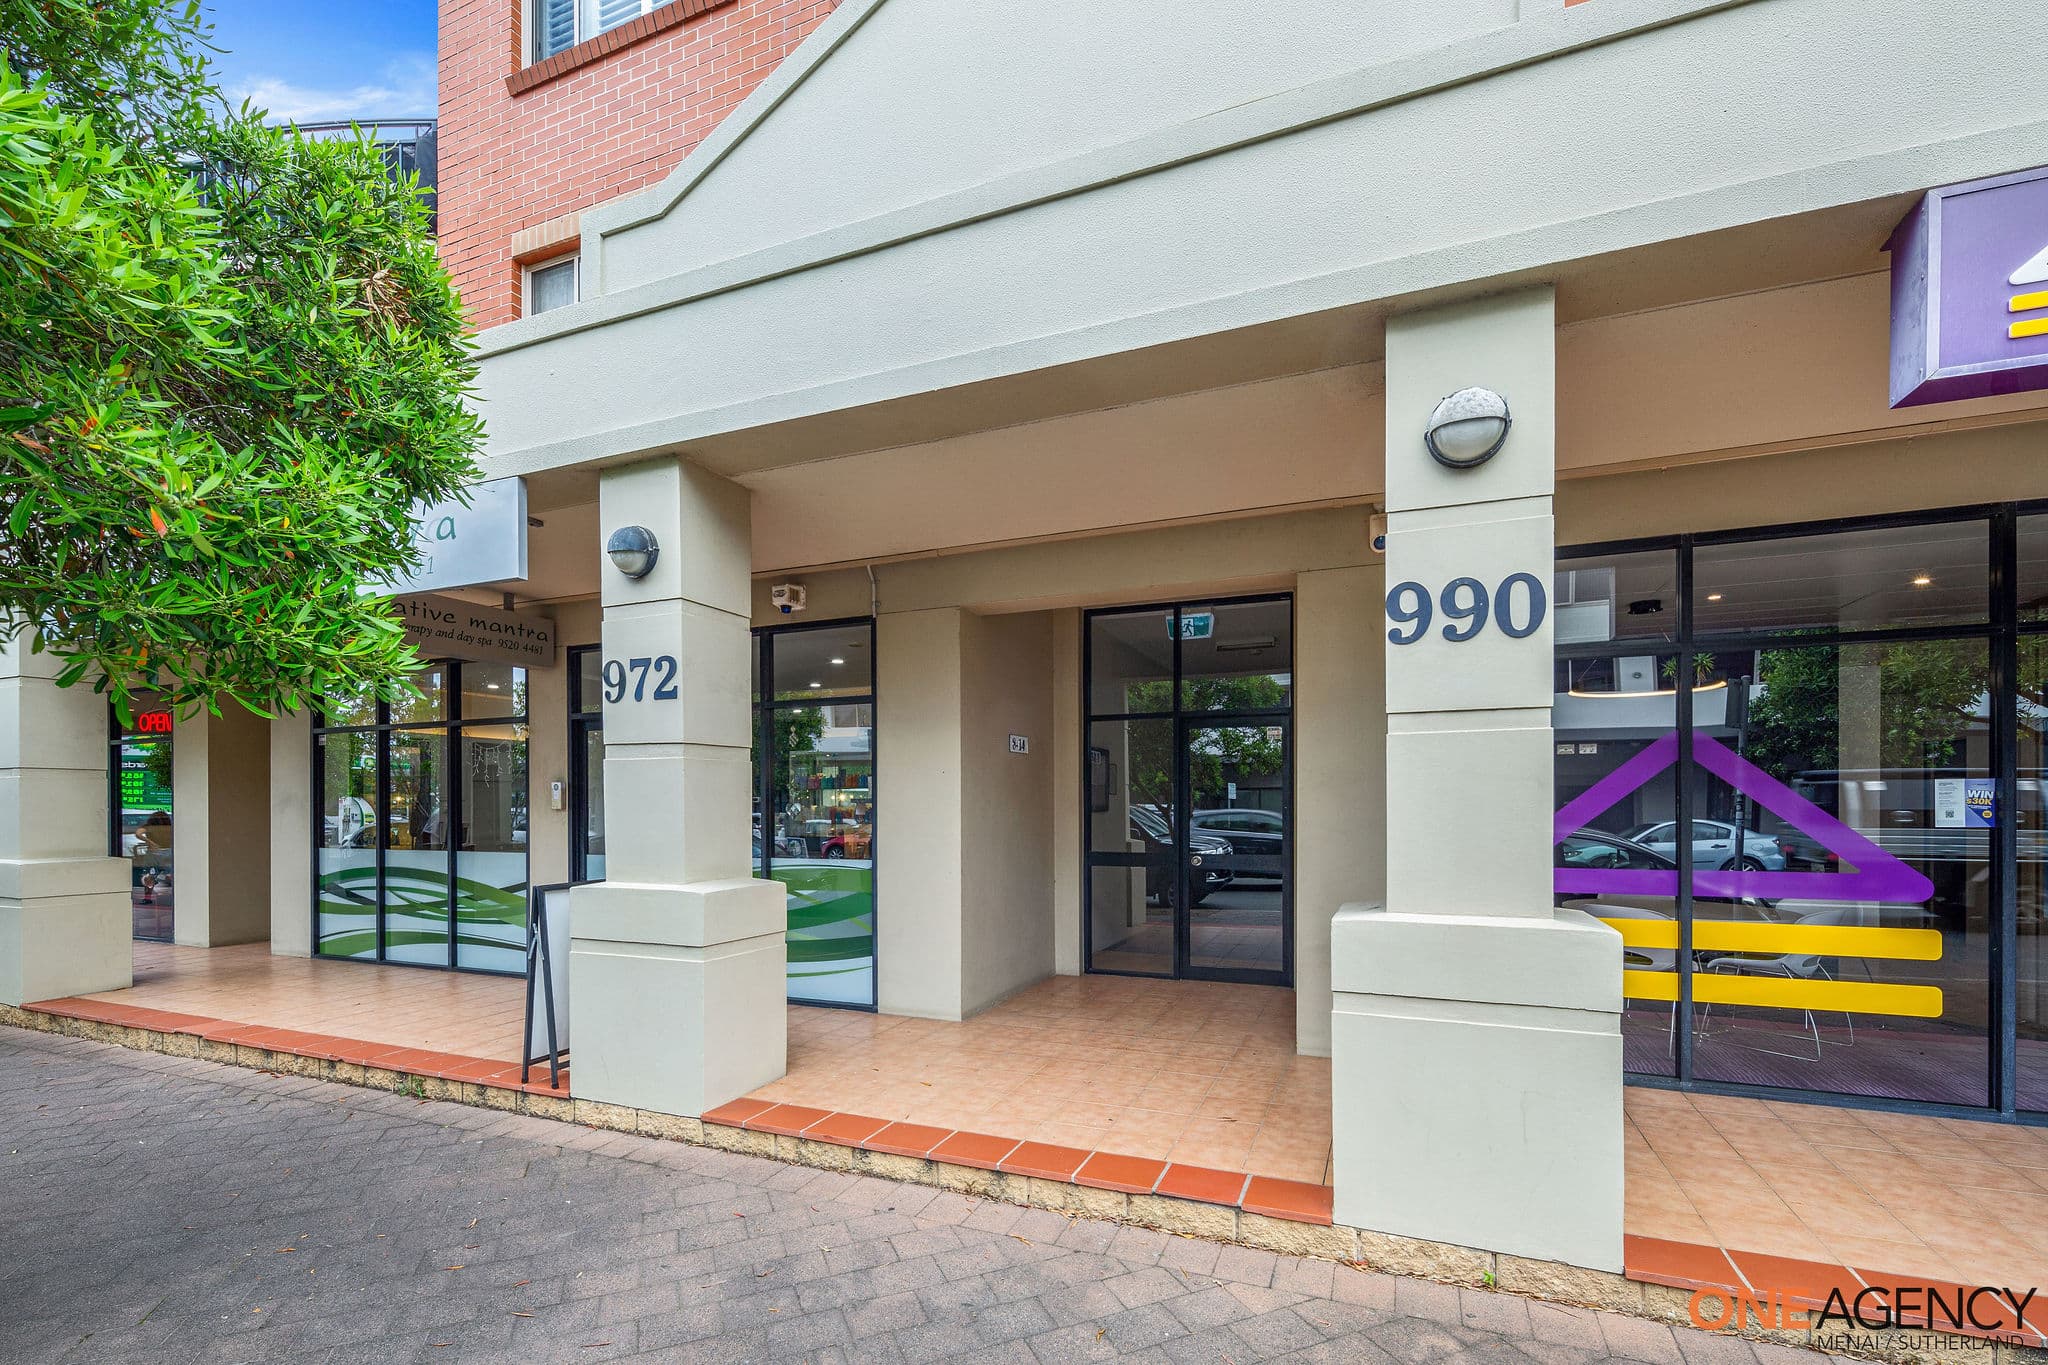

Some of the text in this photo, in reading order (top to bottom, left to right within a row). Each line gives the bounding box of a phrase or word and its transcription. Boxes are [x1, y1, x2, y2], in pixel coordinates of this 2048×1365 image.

[1385, 572, 1547, 645] 990
[435, 628, 455, 639] and
[457, 631, 475, 645] day
[478, 636, 492, 649] spa
[498, 639, 520, 651] 9520
[522, 643, 544, 656] 4481
[470, 616, 548, 642] mantra
[602, 655, 679, 704] 972
[138, 713, 171, 731] OPEN
[1967, 790, 1993, 798] WIN
